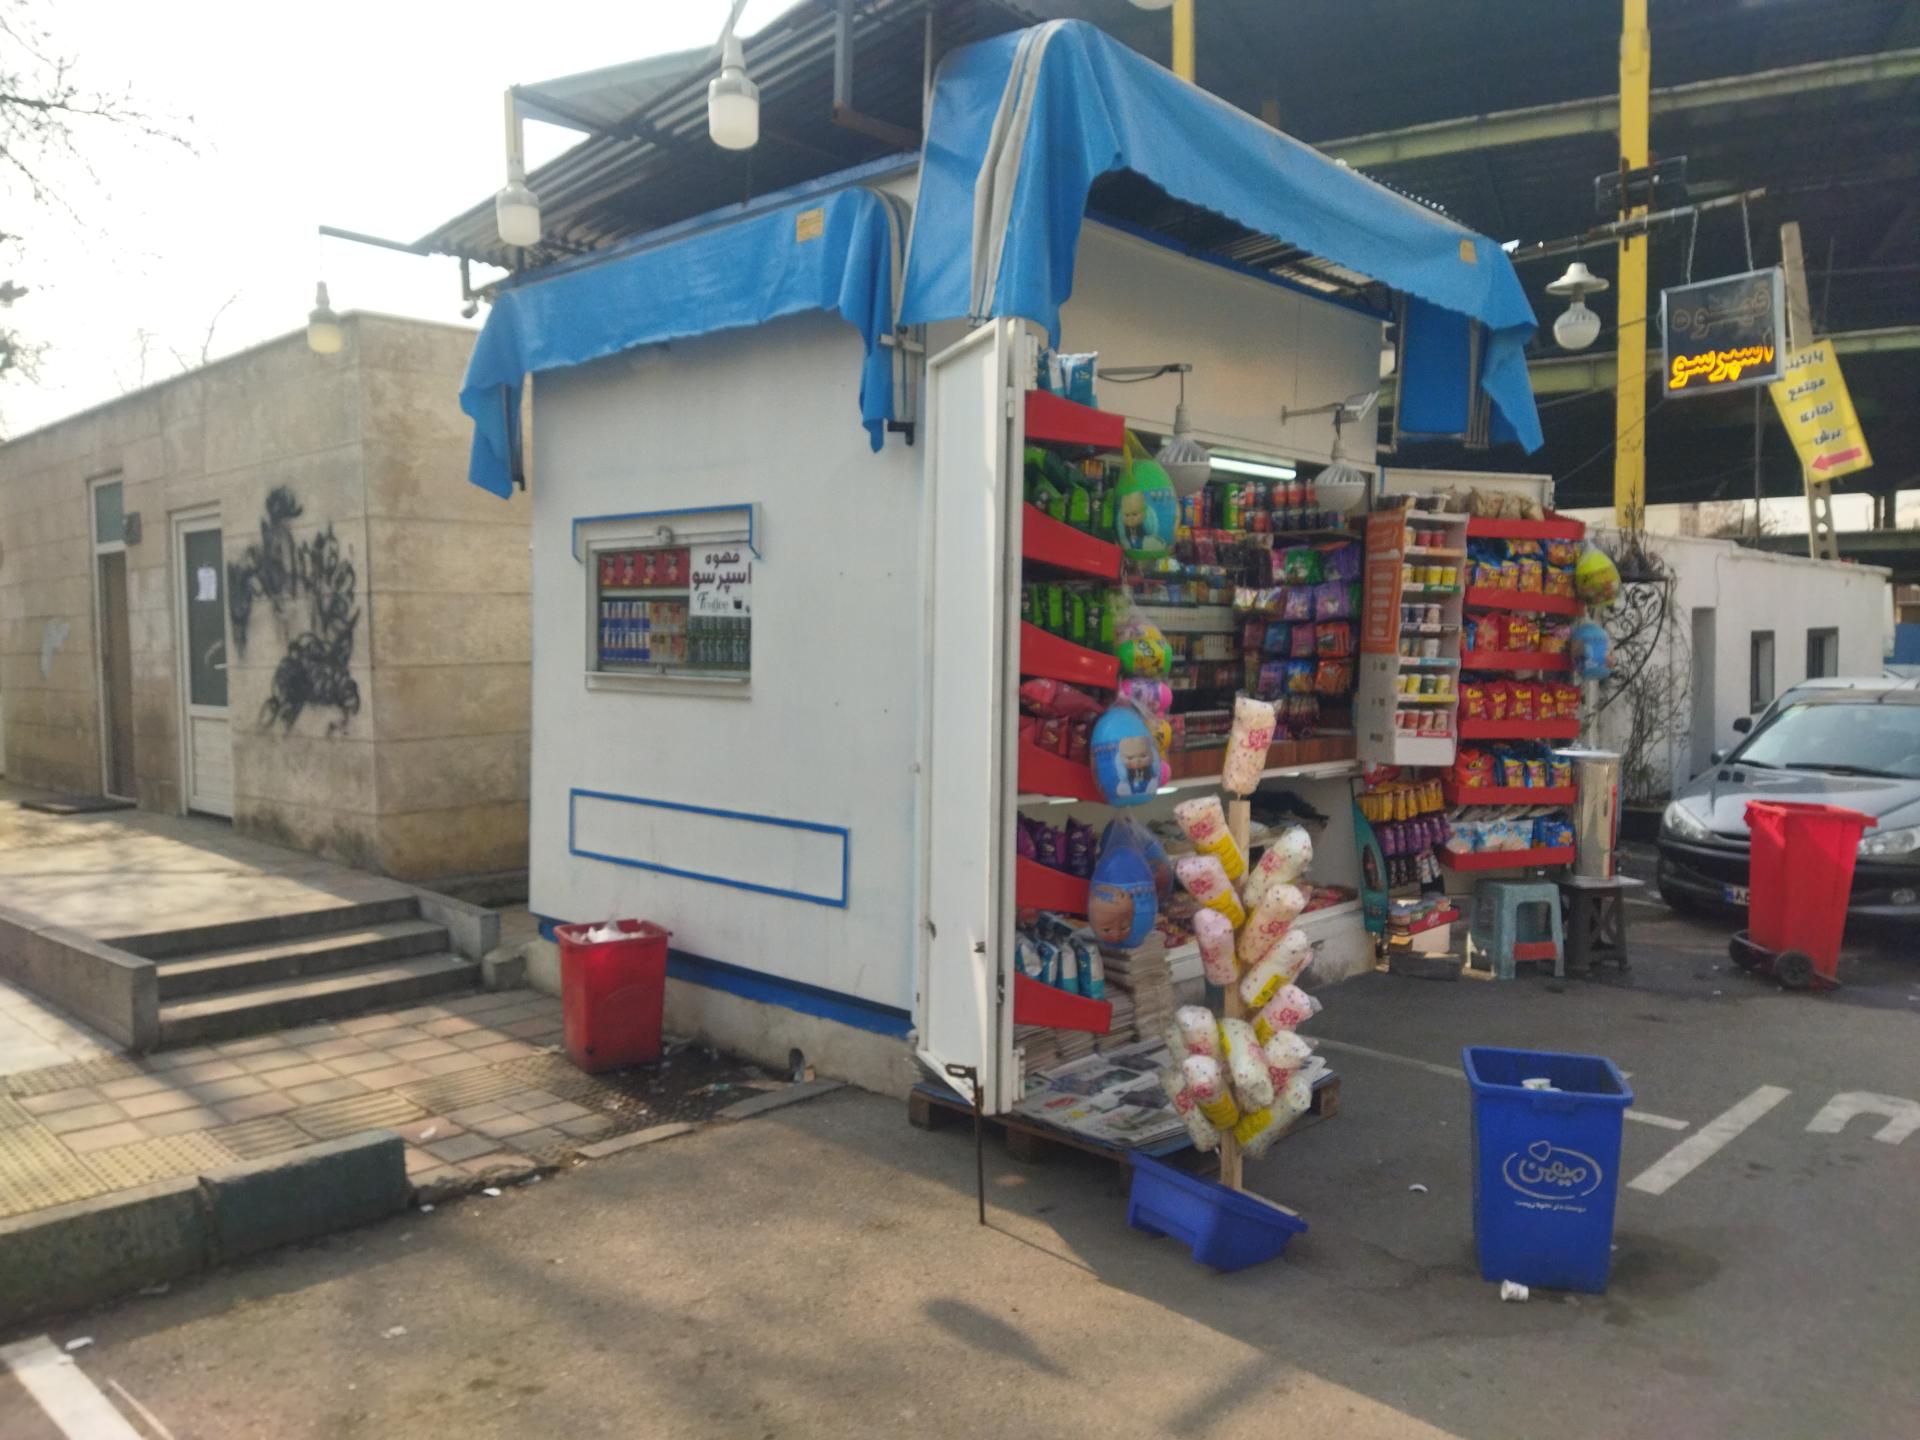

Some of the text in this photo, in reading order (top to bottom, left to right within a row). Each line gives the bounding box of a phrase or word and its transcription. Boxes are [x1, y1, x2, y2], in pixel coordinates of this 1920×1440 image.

[1668, 329, 1775, 390] اسپرسو
[1788, 379, 1826, 401] مجتمع
[705, 550, 740, 569] قهوه
[692, 562, 752, 594] اسپرسو
[1519, 1158, 1587, 1187] میهن
